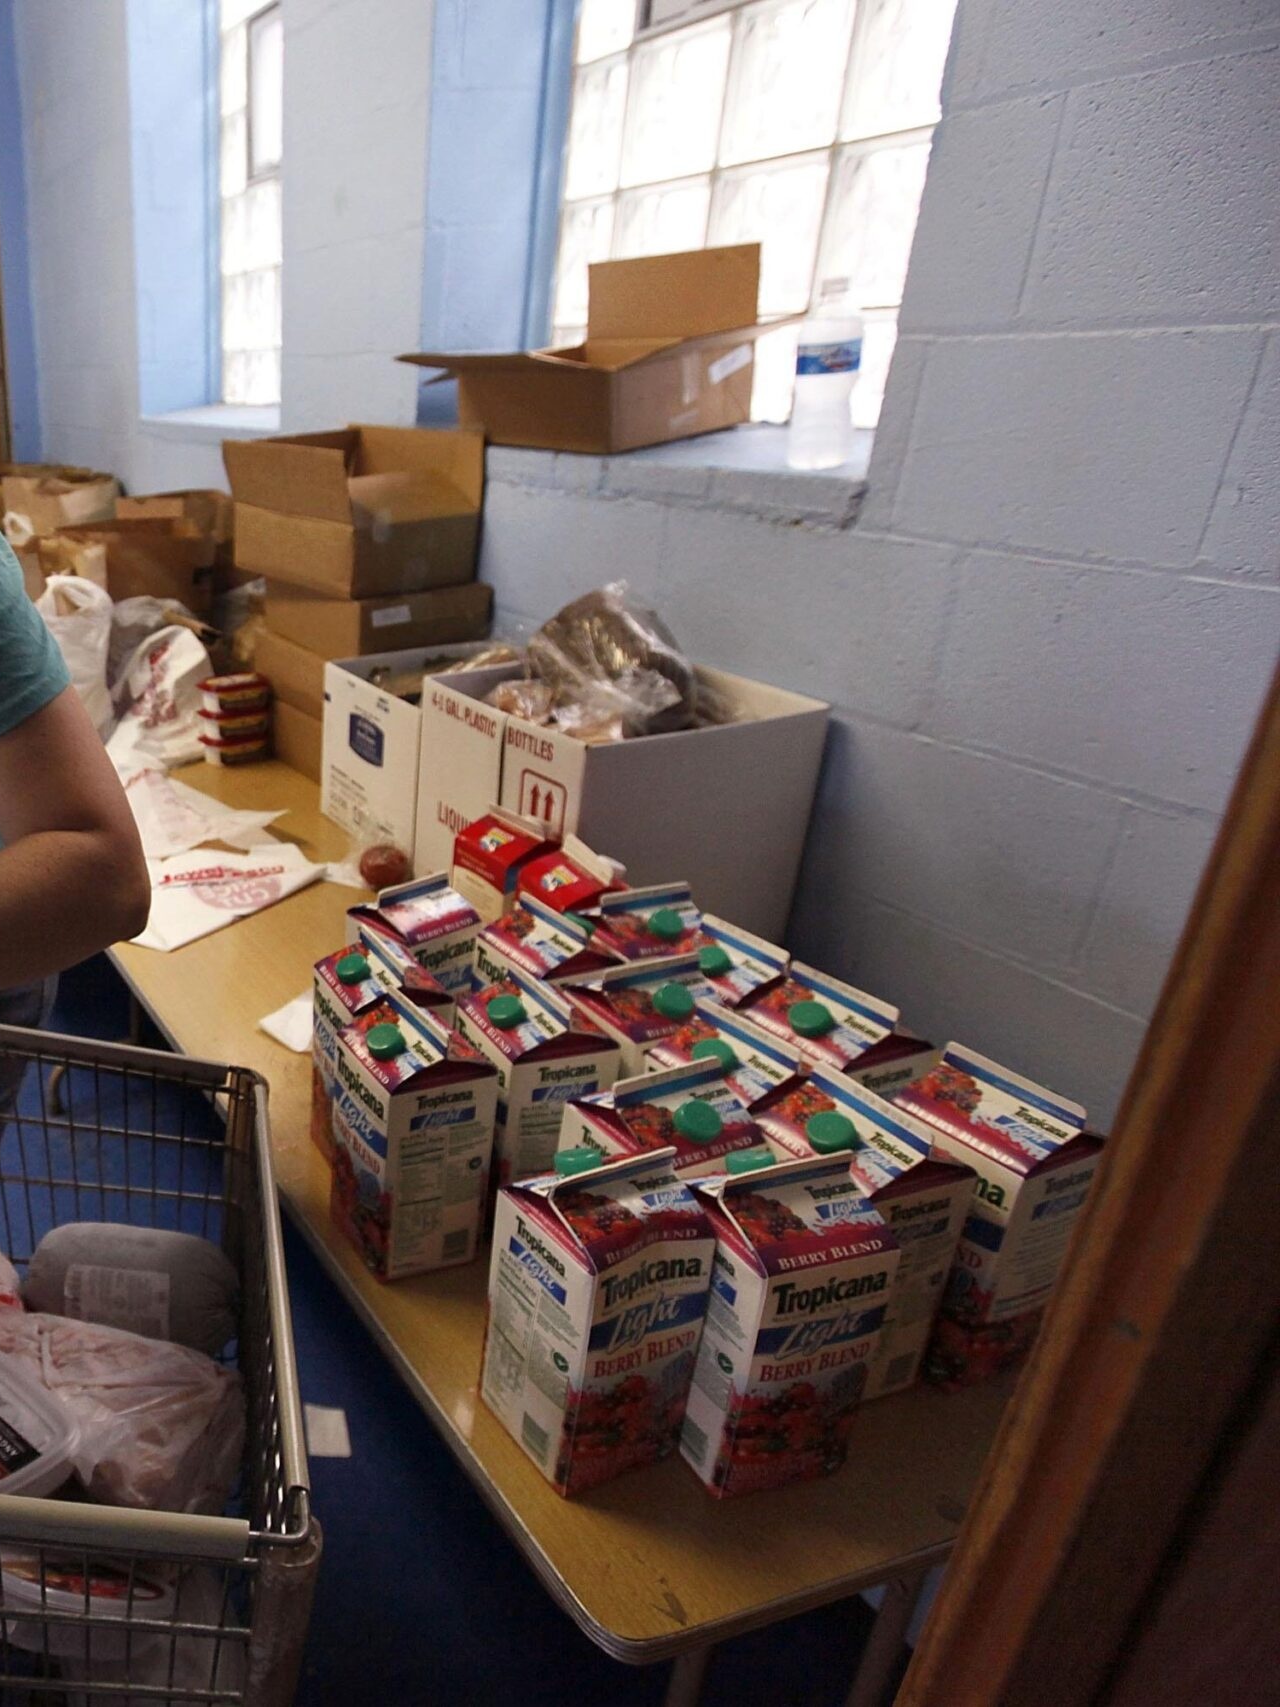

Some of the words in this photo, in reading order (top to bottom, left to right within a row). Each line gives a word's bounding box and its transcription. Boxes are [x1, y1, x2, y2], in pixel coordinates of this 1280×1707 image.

[464, 706, 497, 739] PLASTIC
[507, 726, 554, 762] BOTTLES
[437, 800, 472, 834] LIQU
[477, 945, 506, 983] Tropi
[465, 1005, 488, 1030] BERRY
[486, 1026, 512, 1055] BLEND
[336, 1045, 385, 1120] Tropicana
[538, 1064, 596, 1083] Tropicana
[1014, 1105, 1069, 1139] Tropicana
[870, 1131, 914, 1165] Tropicana
[828, 1199, 863, 1220] Light
[516, 1214, 566, 1277] Tropicana
[778, 1250, 828, 1271] BERRY
[830, 1239, 883, 1260] BLEND
[601, 1257, 703, 1309] Tropicana
[772, 1271, 888, 1316] Tropicana
[607, 1295, 681, 1355] Light
[775, 1310, 861, 1361] Light
[593, 1347, 644, 1378] BERRY
[646, 1331, 696, 1363] BLEND
[759, 1358, 818, 1383] BERRY
[819, 1342, 870, 1371] BLEND
